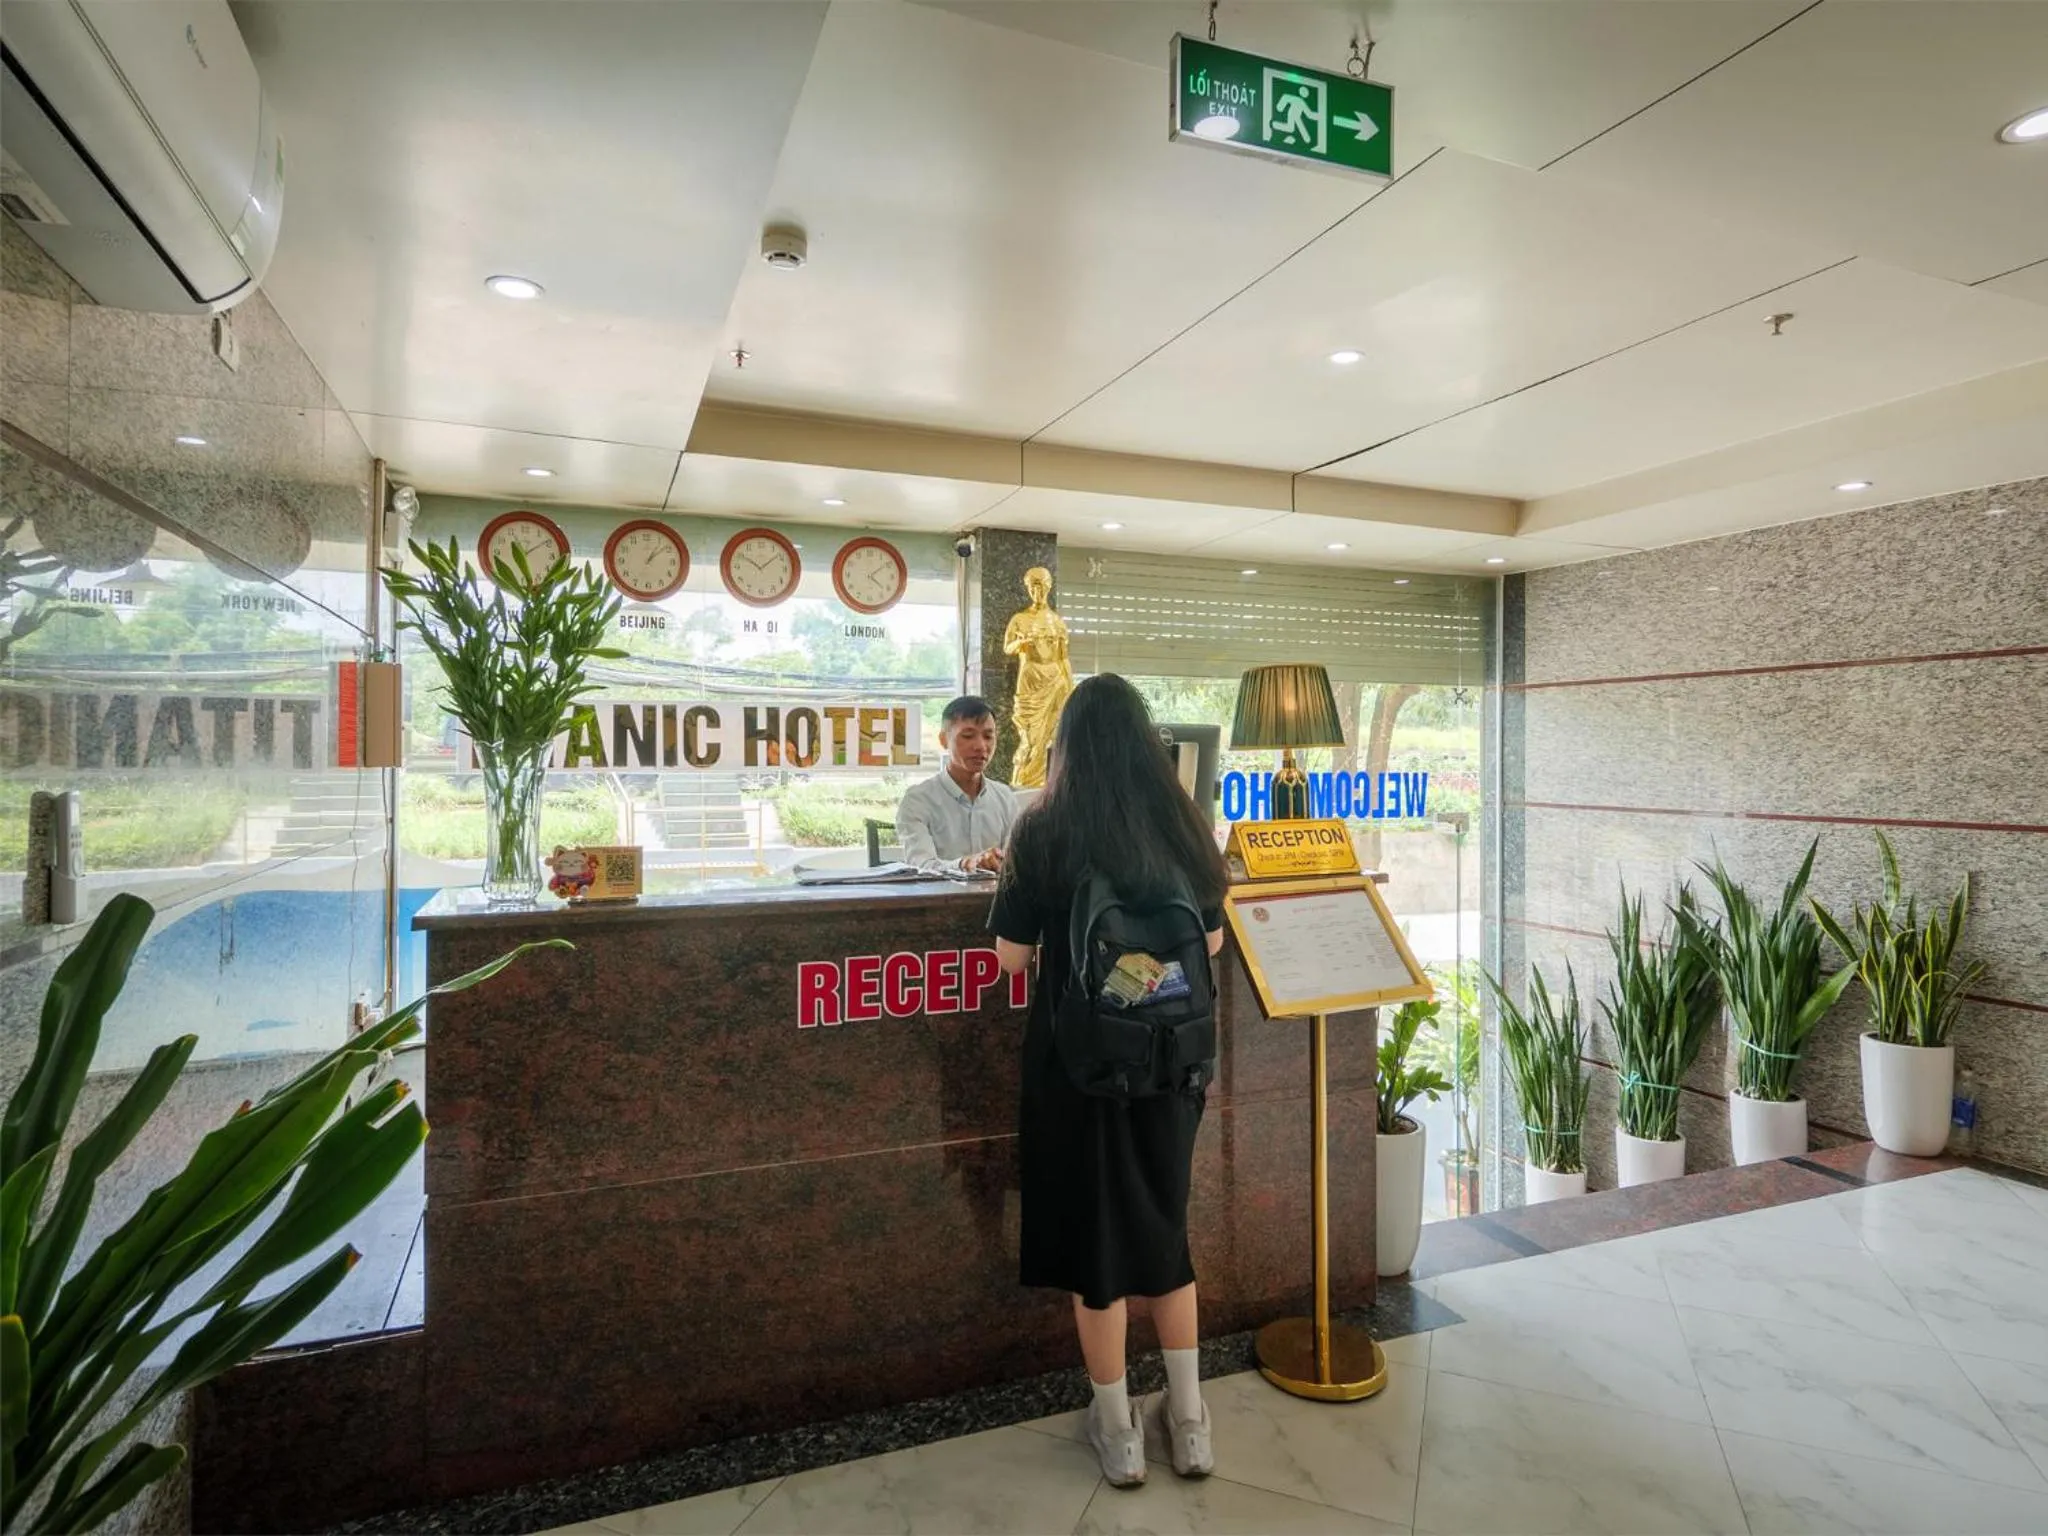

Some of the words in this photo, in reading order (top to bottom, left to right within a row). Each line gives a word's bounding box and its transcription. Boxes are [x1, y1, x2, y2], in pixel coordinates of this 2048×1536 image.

[1190, 69, 1210, 97] LỐI
[1214, 80, 1256, 107] THOÁT
[1209, 101, 1237, 117] EXIT
[619, 615, 665, 629] BEIJING
[844, 624, 886, 639] LONDON
[471, 703, 721, 769] ANIC
[743, 703, 921, 768] HOTEL
[1246, 827, 1345, 849] RECEPTION
